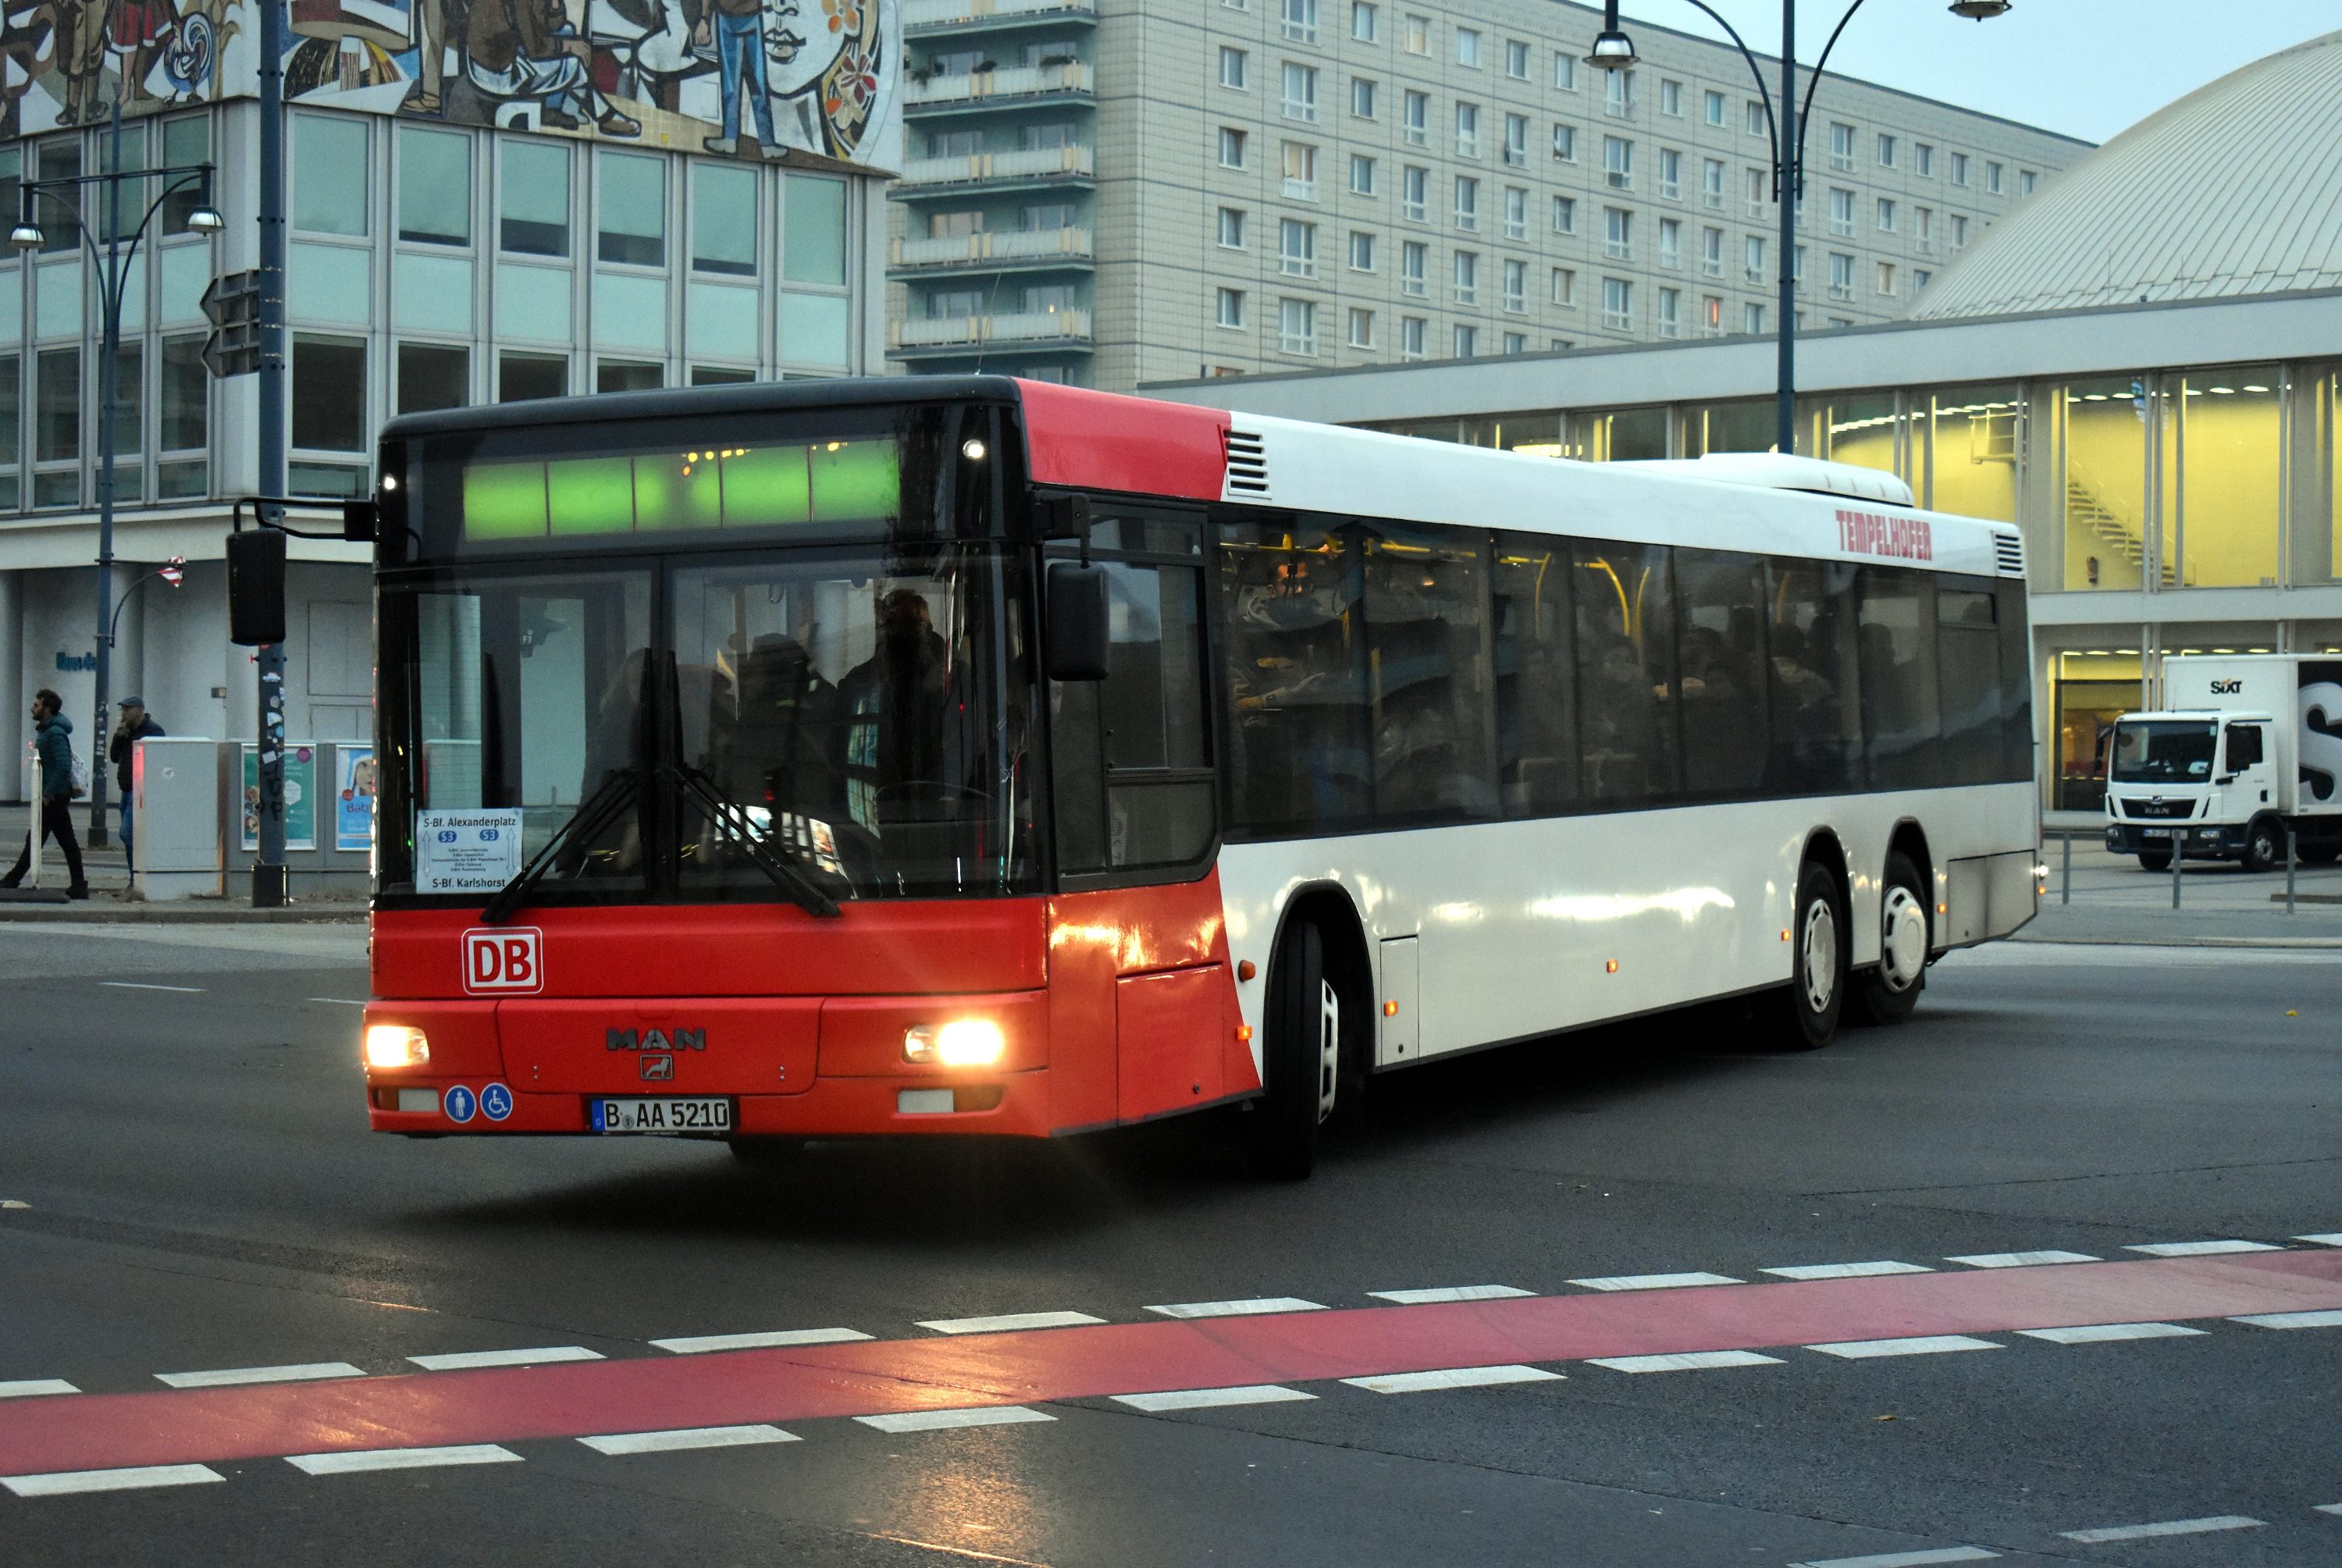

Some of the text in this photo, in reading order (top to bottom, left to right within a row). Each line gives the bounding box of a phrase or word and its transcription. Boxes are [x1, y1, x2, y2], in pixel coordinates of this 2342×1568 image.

[1835, 510, 1932, 560] TEMPELHOFER
[424, 817, 516, 828] S-Bf. Alexanderplatz
[441, 830, 496, 841] S3 S3
[432, 878, 506, 888] S-Bf. Karlshorst
[472, 939, 532, 983] DB
[606, 1029, 707, 1051] MAN
[605, 1103, 728, 1128] B AA 5210
